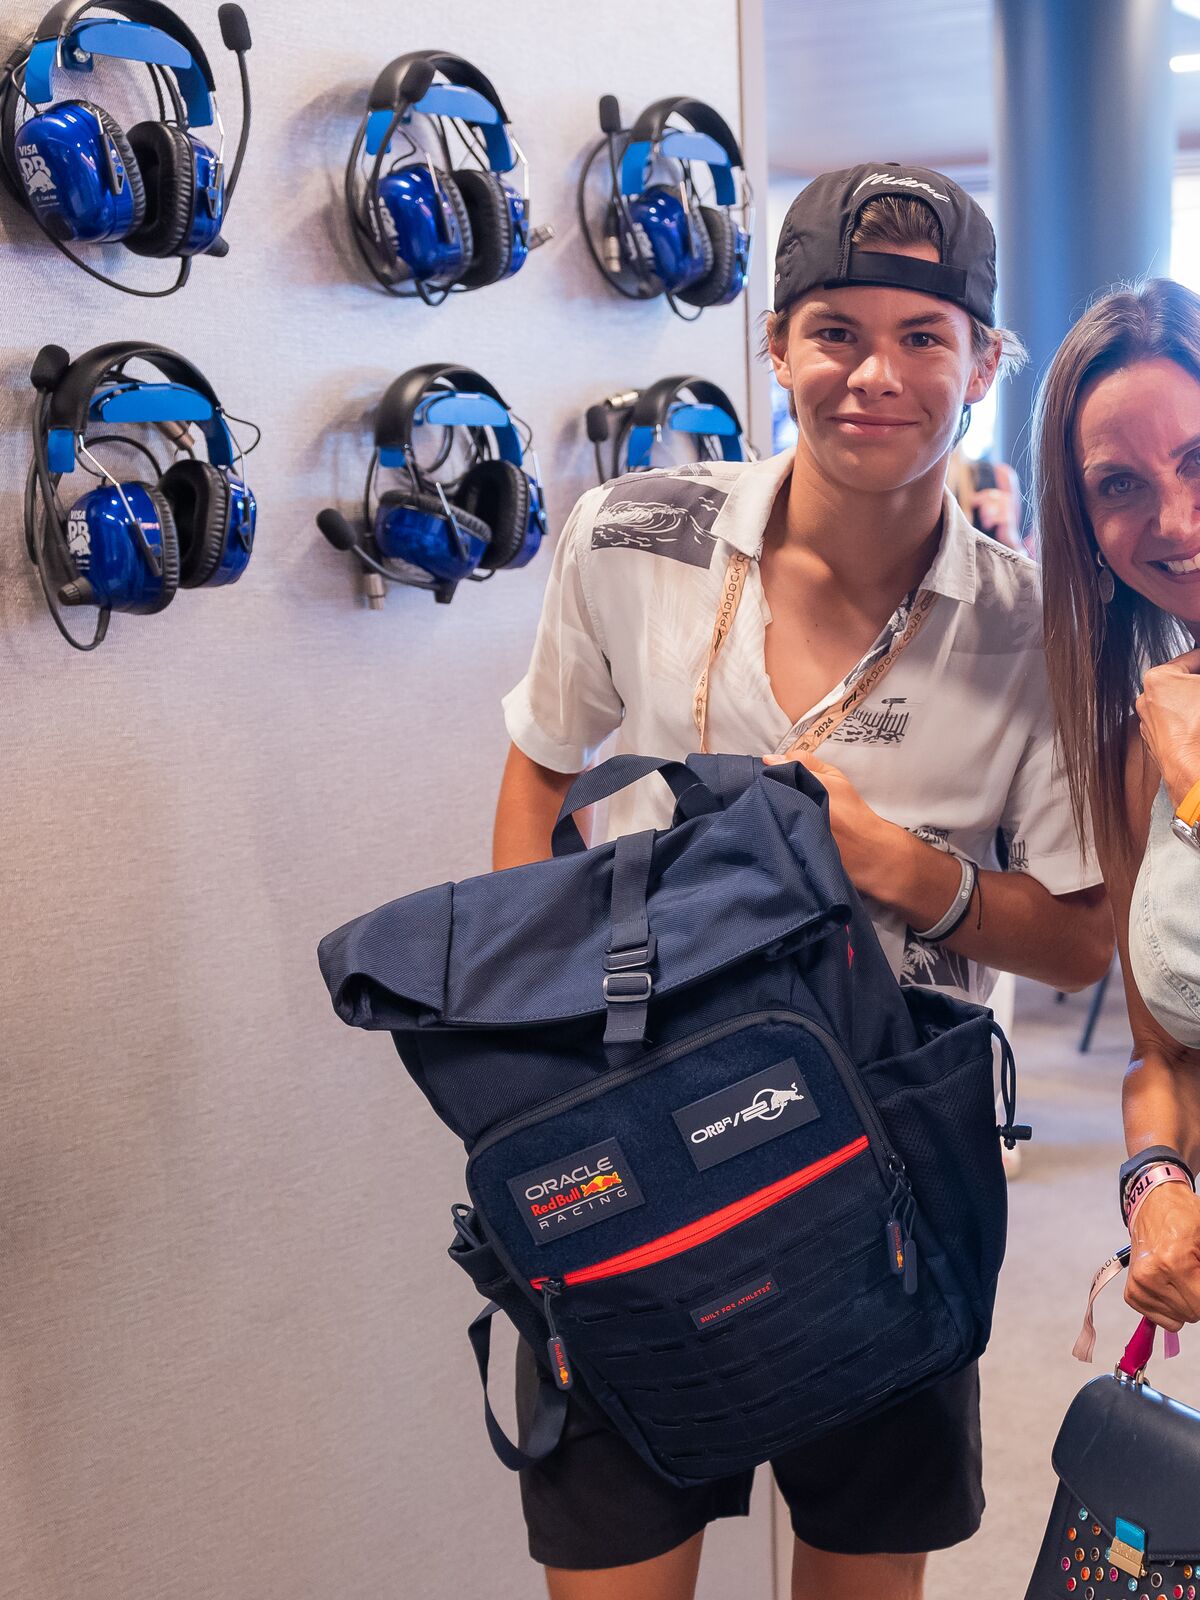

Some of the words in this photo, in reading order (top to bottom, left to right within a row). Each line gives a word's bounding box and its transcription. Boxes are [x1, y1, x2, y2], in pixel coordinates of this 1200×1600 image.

[18, 143, 39, 157] VISA
[70, 510, 87, 520] VISA
[720, 567, 742, 627] PADDOCK
[813, 716, 834, 738] 2024
[858, 646, 903, 693] PADDOCK
[903, 612, 922, 642] CLUB
[525, 1156, 614, 1200] ORACLE
[539, 1188, 628, 1230] RACING
[700, 1310, 720, 1323] BUILT
[721, 1303, 737, 1313] FOR
[737, 1285, 771, 1306] ATHLETES
